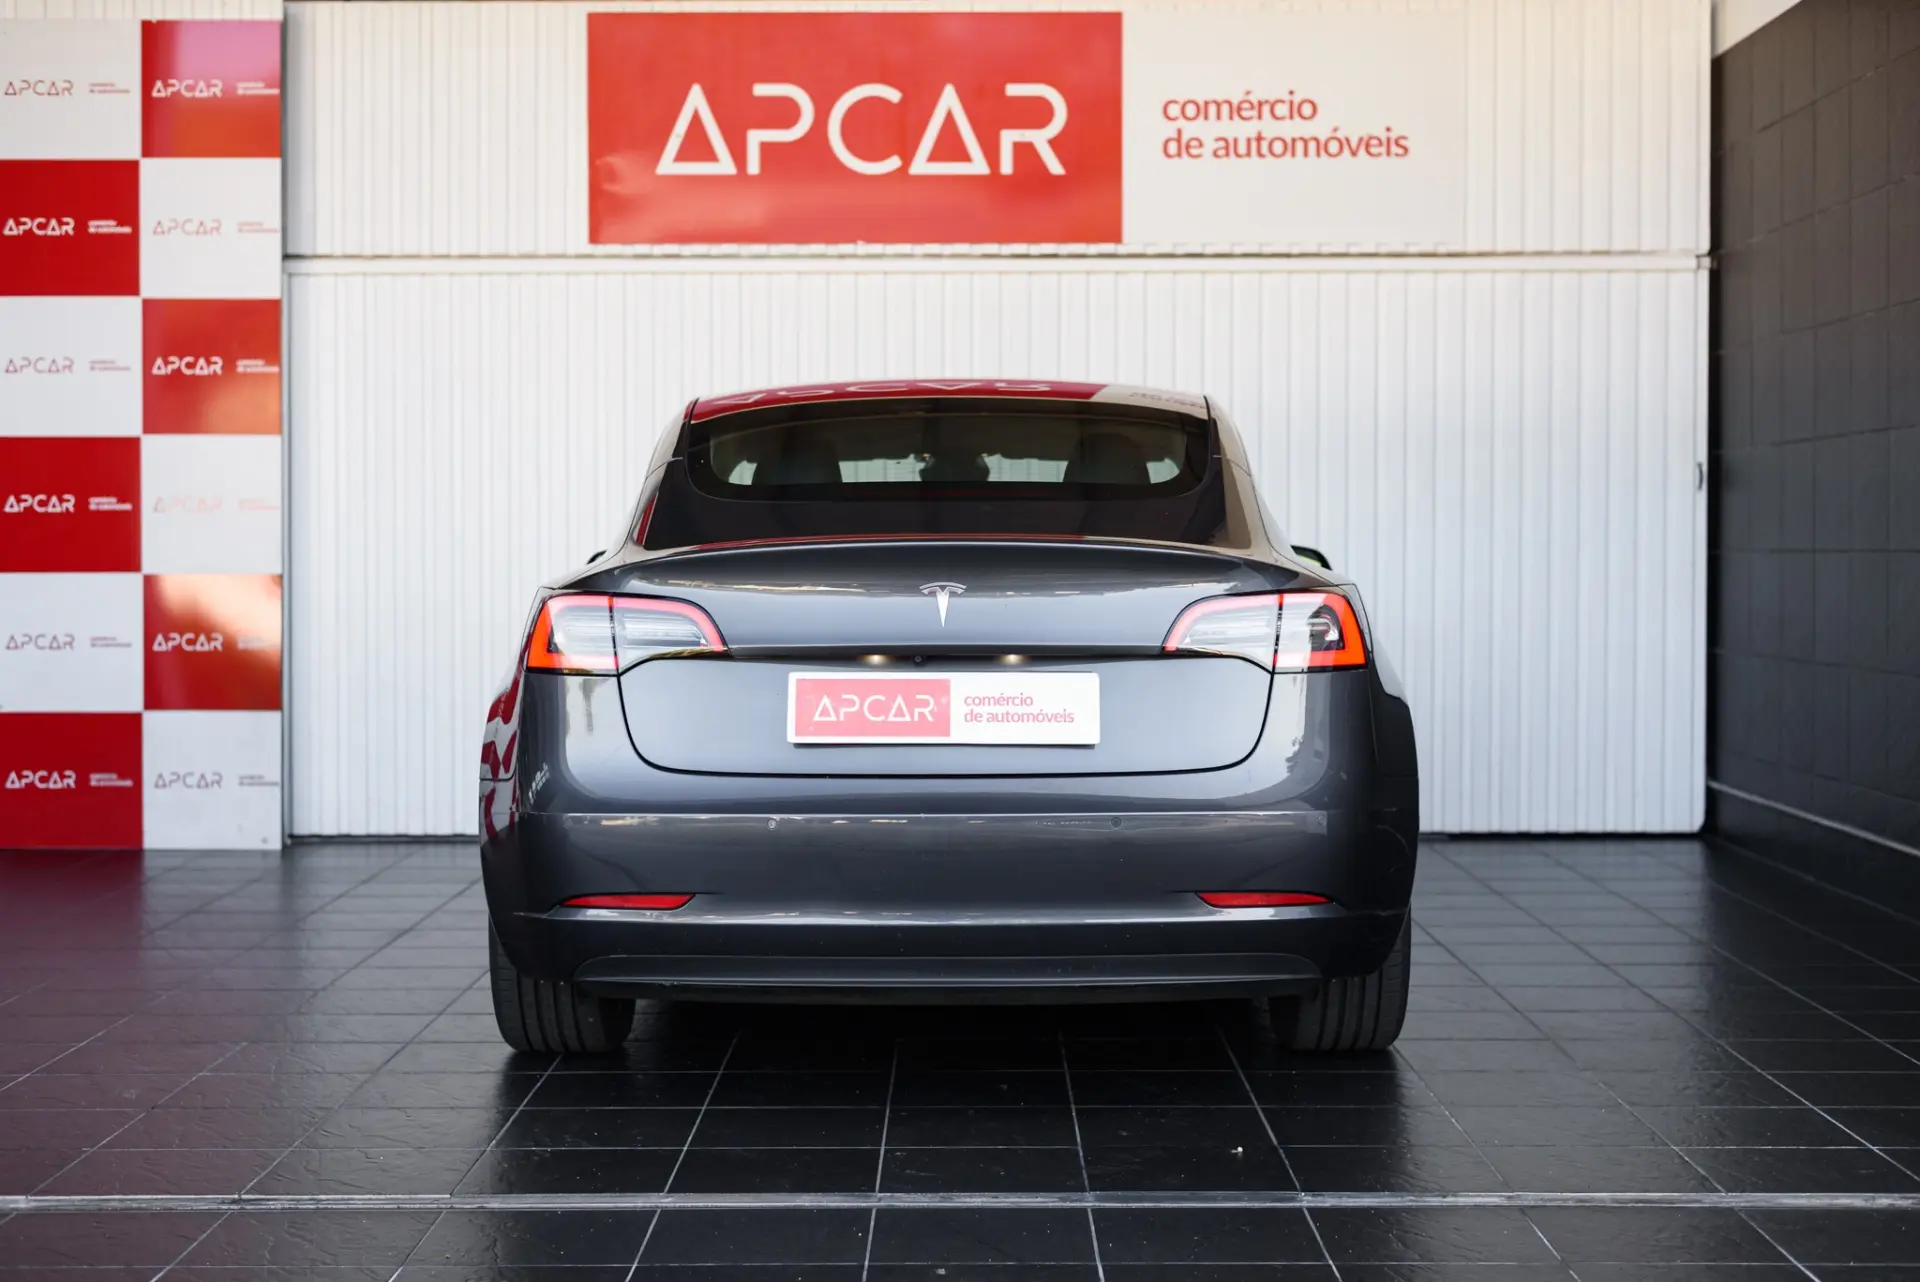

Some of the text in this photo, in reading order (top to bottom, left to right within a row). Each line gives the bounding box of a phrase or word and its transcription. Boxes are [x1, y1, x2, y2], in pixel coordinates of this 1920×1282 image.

[4, 79, 75, 97] APCAR
[151, 79, 223, 98] APCAR
[1162, 90, 1319, 121] comércio
[655, 82, 1068, 176] APCAR
[1162, 126, 1410, 159] de automóveis
[2, 217, 75, 236] APCAR
[152, 218, 222, 236] APCAR
[4, 356, 75, 374] APCAR
[151, 356, 223, 375] APCAR
[3, 494, 76, 513] APCAR
[5, 633, 76, 651] APCAR
[152, 632, 223, 652] APCAR
[812, 693, 935, 722] APCAR
[963, 692, 1034, 707] comércio
[963, 707, 1075, 723] de automóveis
[4, 770, 77, 789] APCAR
[153, 772, 223, 789] APCAR
